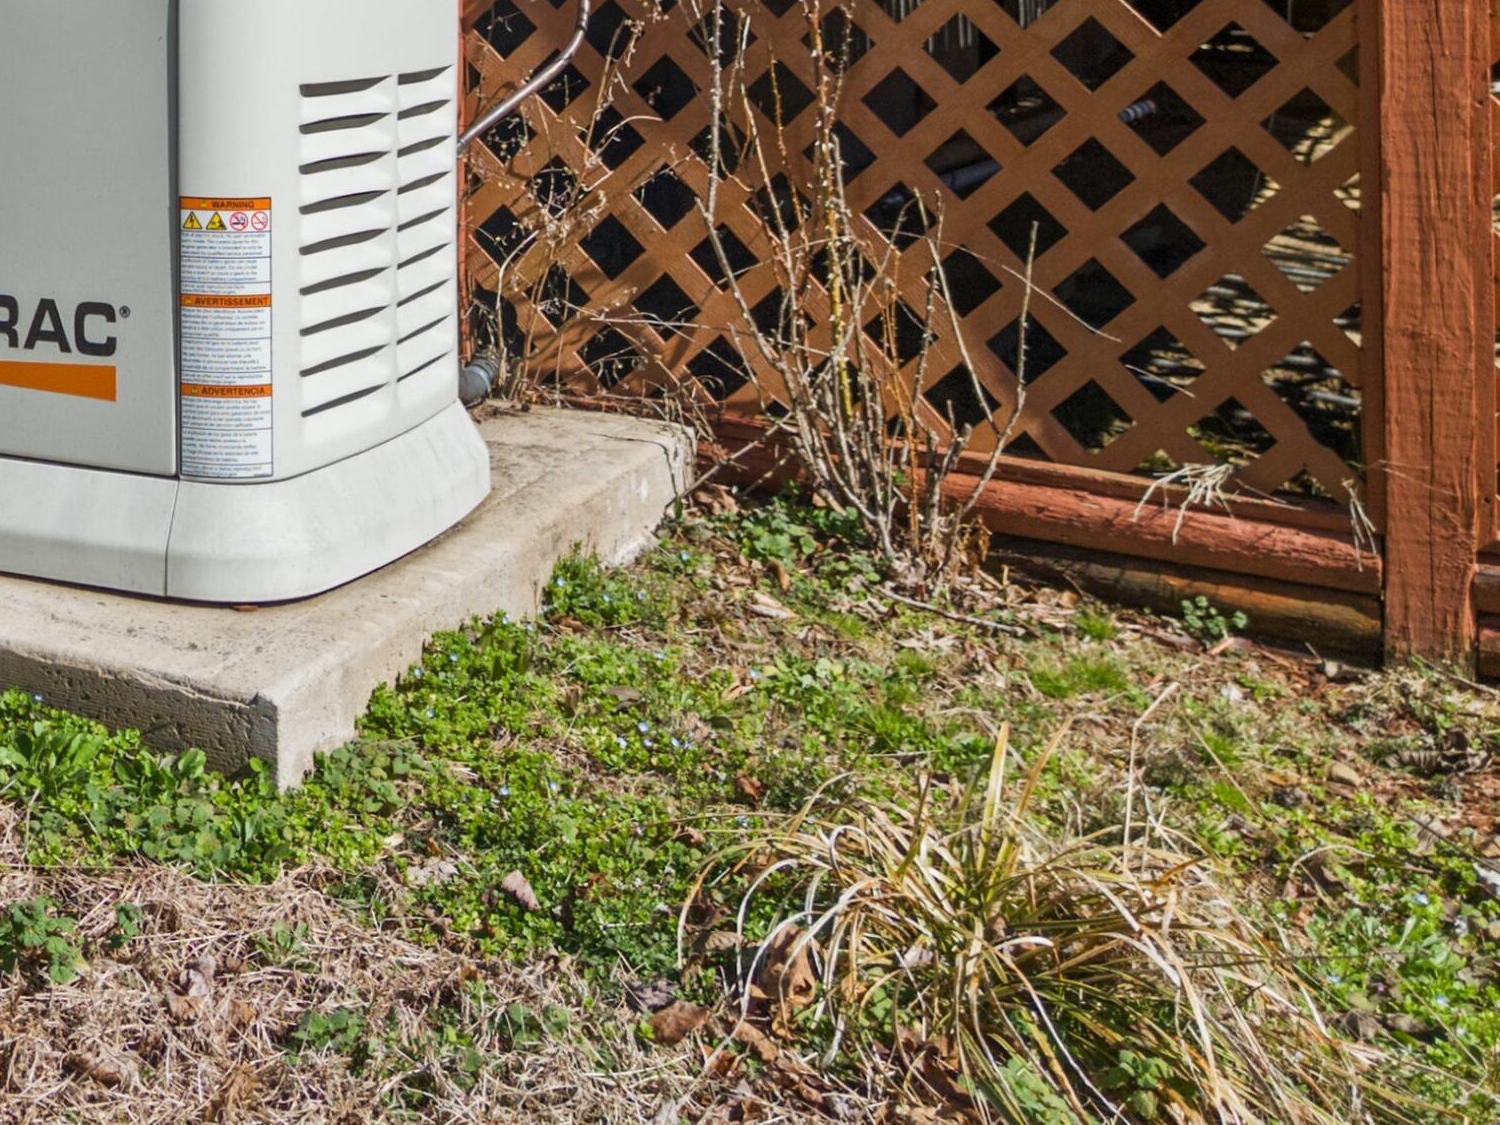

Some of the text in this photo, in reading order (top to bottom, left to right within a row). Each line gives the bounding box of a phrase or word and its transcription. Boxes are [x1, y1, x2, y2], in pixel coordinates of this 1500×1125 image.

[212, 201, 254, 209] WARNING
[194, 297, 269, 306] AVERTISSEMENT
[202, 387, 265, 395] ADVERTENCIA
